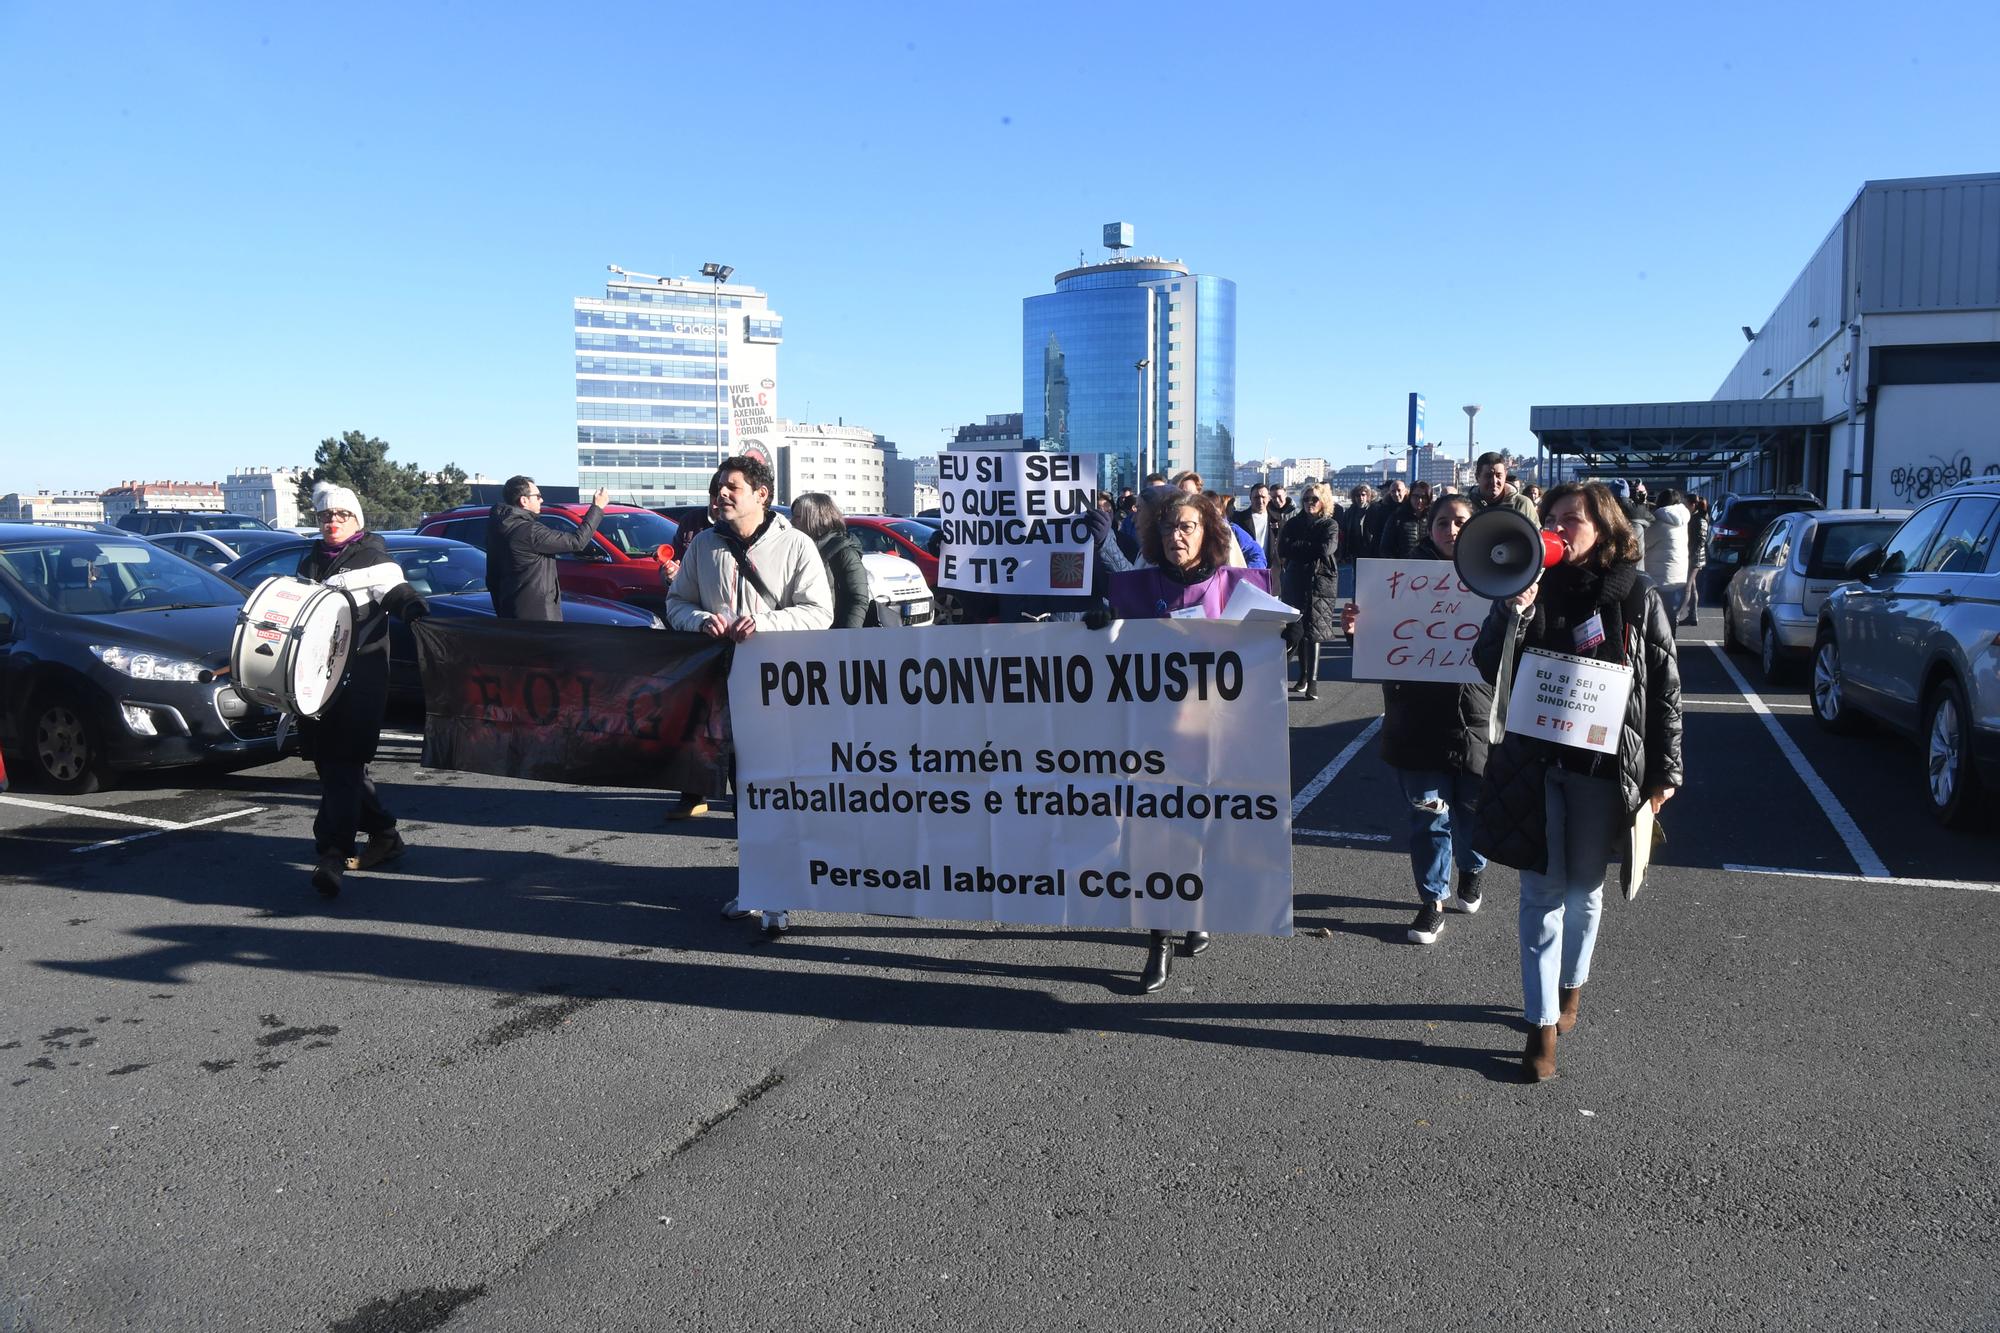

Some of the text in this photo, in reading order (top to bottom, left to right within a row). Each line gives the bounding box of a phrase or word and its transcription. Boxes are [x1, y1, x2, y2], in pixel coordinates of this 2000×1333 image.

[674, 322, 727, 336] endesa
[729, 384, 750, 394] VIVE
[731, 392, 767, 408] Km.C
[734, 407, 765, 418] AXENDA
[734, 416, 774, 427] CULTURAL
[939, 455, 1080, 482] EU SI SEI
[942, 489, 1096, 517] O QUE E UN
[942, 518, 1092, 545] SINDICATO
[944, 554, 1019, 584] E TI?
[1430, 601, 1461, 614] EN
[1393, 619, 1480, 640] CCO
[760, 650, 1244, 706] POR UN CONVENIO XUSTO
[1536, 669, 1606, 691] EU SI SEI O
[1539, 682, 1598, 702] QUE E UN
[471, 673, 723, 741] FOLGA
[1536, 694, 1596, 713] SINDICATO
[1536, 715, 1574, 732] E TI?
[831, 741, 1166, 775] Nós tamén somos
[746, 781, 1278, 820] traballadores e traballadoras
[809, 859, 1204, 901] Persoal laboral CC.OO
